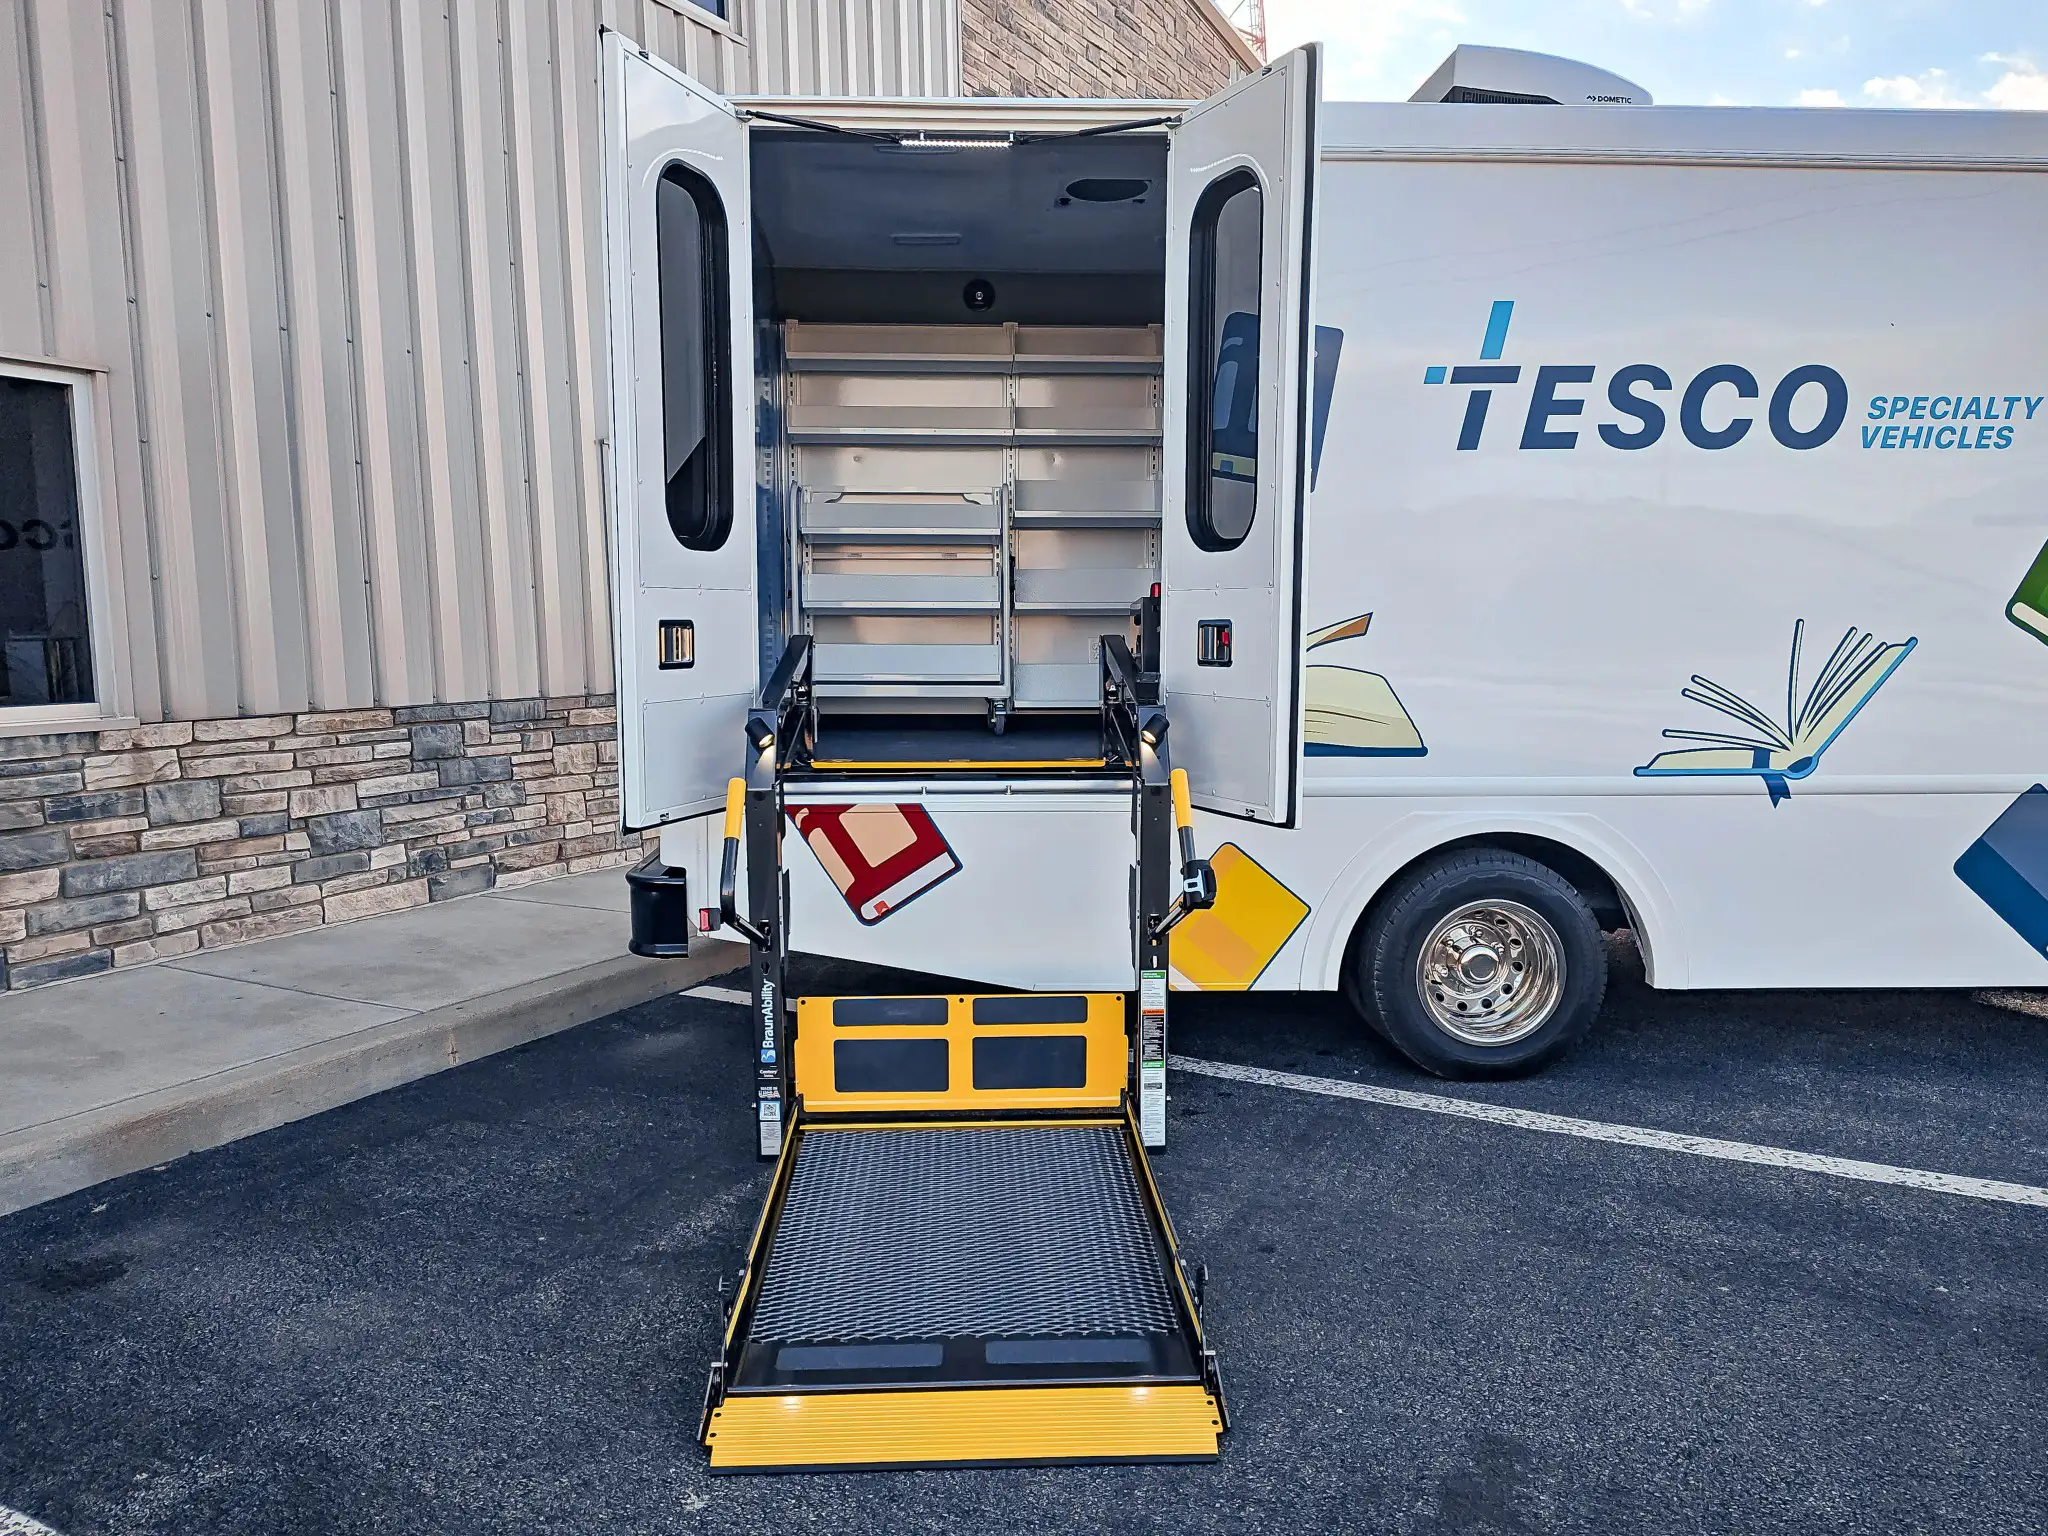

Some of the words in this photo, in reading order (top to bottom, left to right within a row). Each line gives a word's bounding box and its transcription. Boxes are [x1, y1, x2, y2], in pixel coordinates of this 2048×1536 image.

[1597, 95, 1632, 104] DOMETIC
[1424, 301, 1848, 450] TESCO
[1867, 396, 2045, 420] SPECIALTY
[1861, 426, 2015, 449] VEHICLES
[761, 980, 776, 1049] BraunAbility
